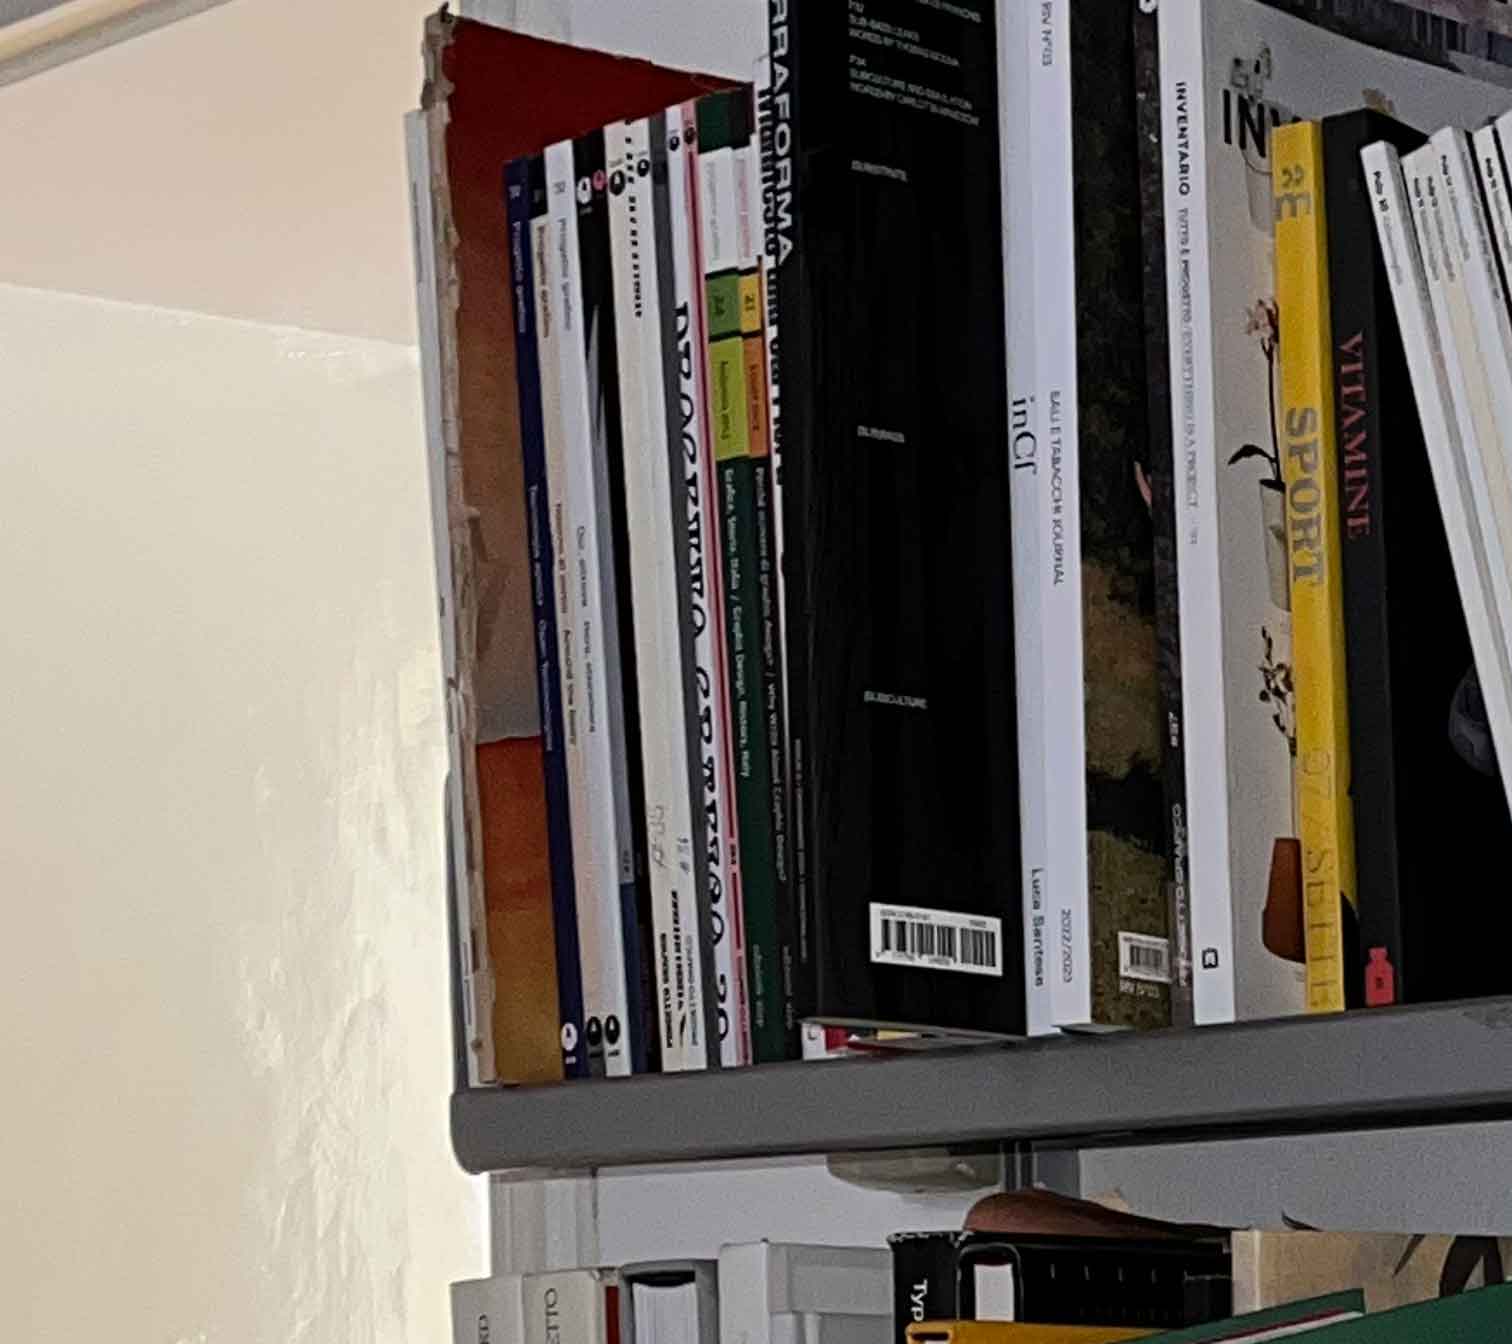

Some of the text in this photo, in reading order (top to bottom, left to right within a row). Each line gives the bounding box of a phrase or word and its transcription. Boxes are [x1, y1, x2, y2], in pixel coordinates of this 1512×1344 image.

[1175, 81, 1192, 196] INVENTARIO
[1285, 407, 1325, 588] SPORT
[1337, 332, 1372, 540] VITAMINE
